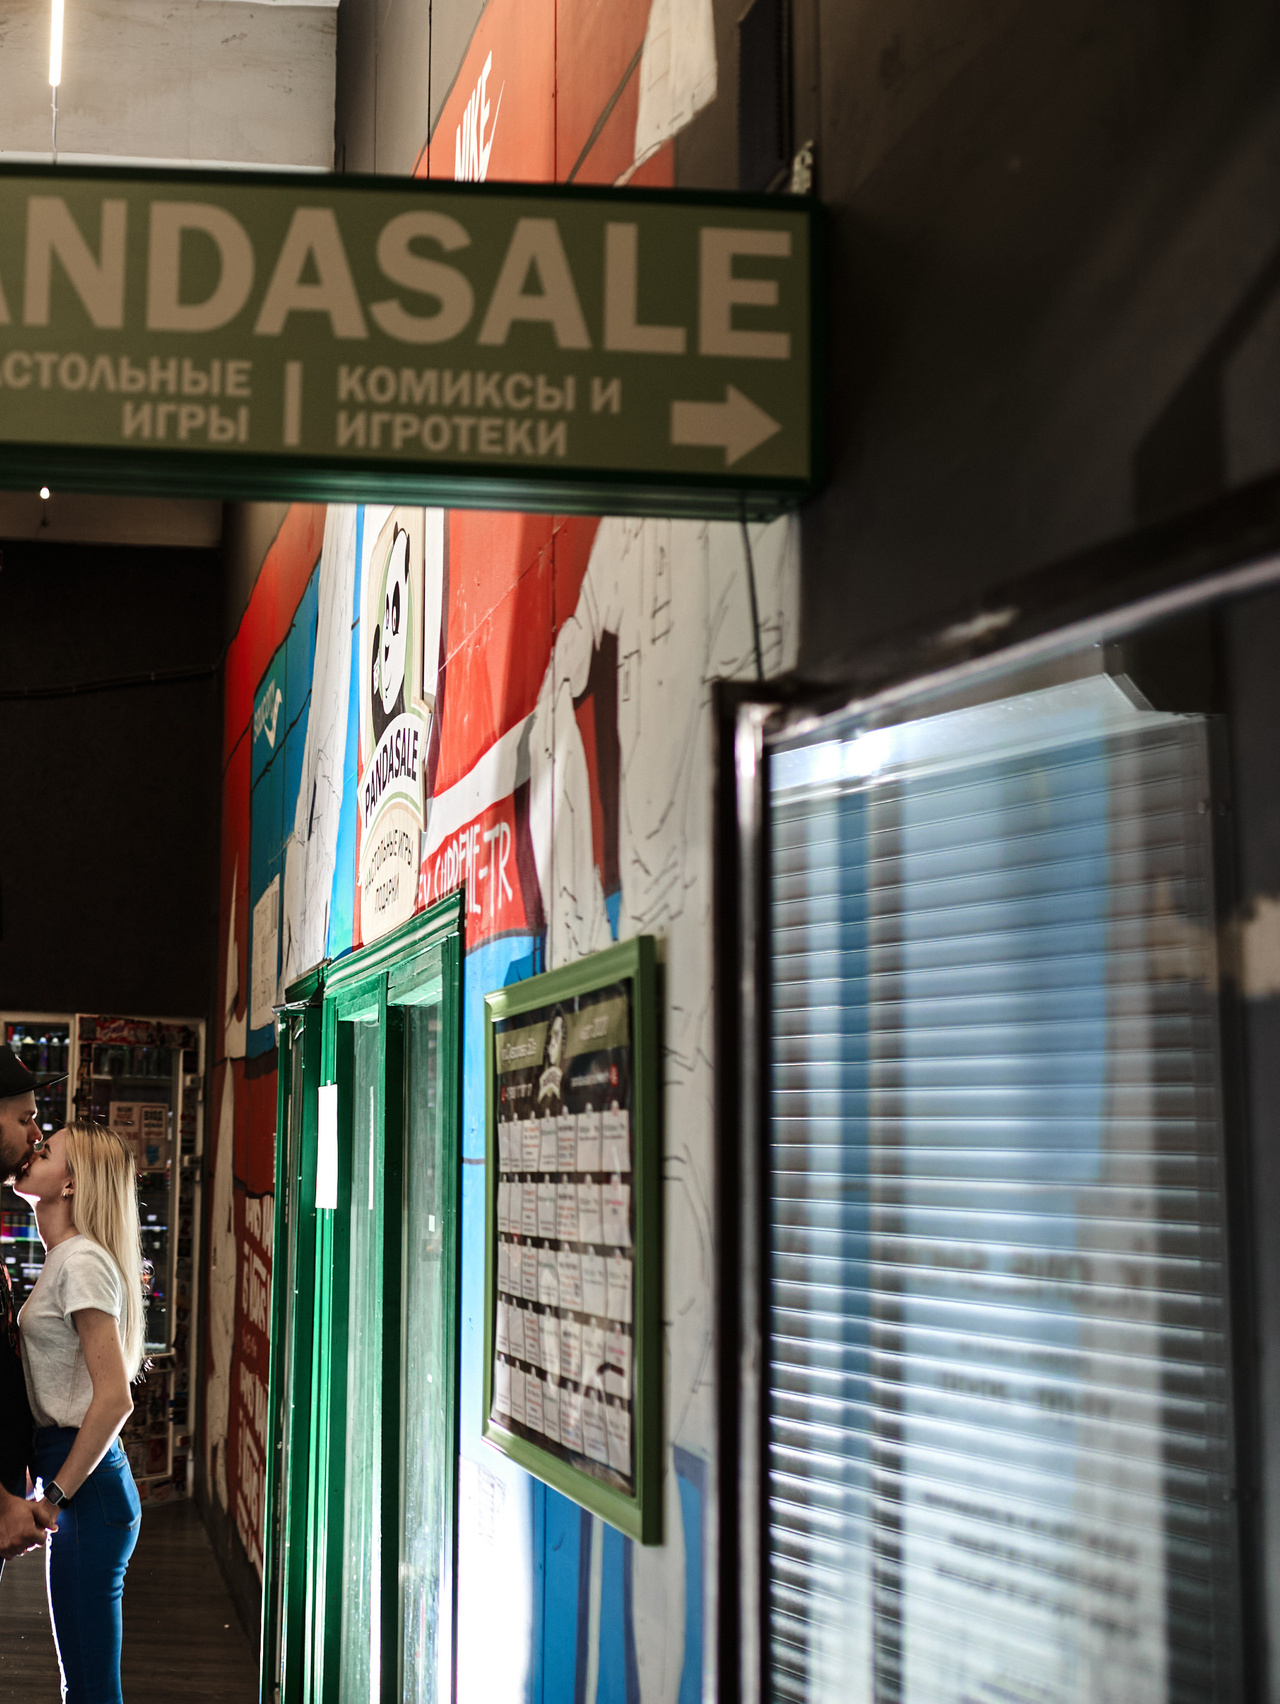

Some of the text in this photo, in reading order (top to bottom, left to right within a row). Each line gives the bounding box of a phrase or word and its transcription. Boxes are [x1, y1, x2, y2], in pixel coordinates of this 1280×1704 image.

[454, 50, 492, 183] NIKE
[336, 364, 622, 416] КОМИКСЫ И
[122, 399, 251, 444] ИГРЫ
[336, 411, 568, 458] ИГРОТЕКИ
[365, 728, 419, 829] PANDASALE
